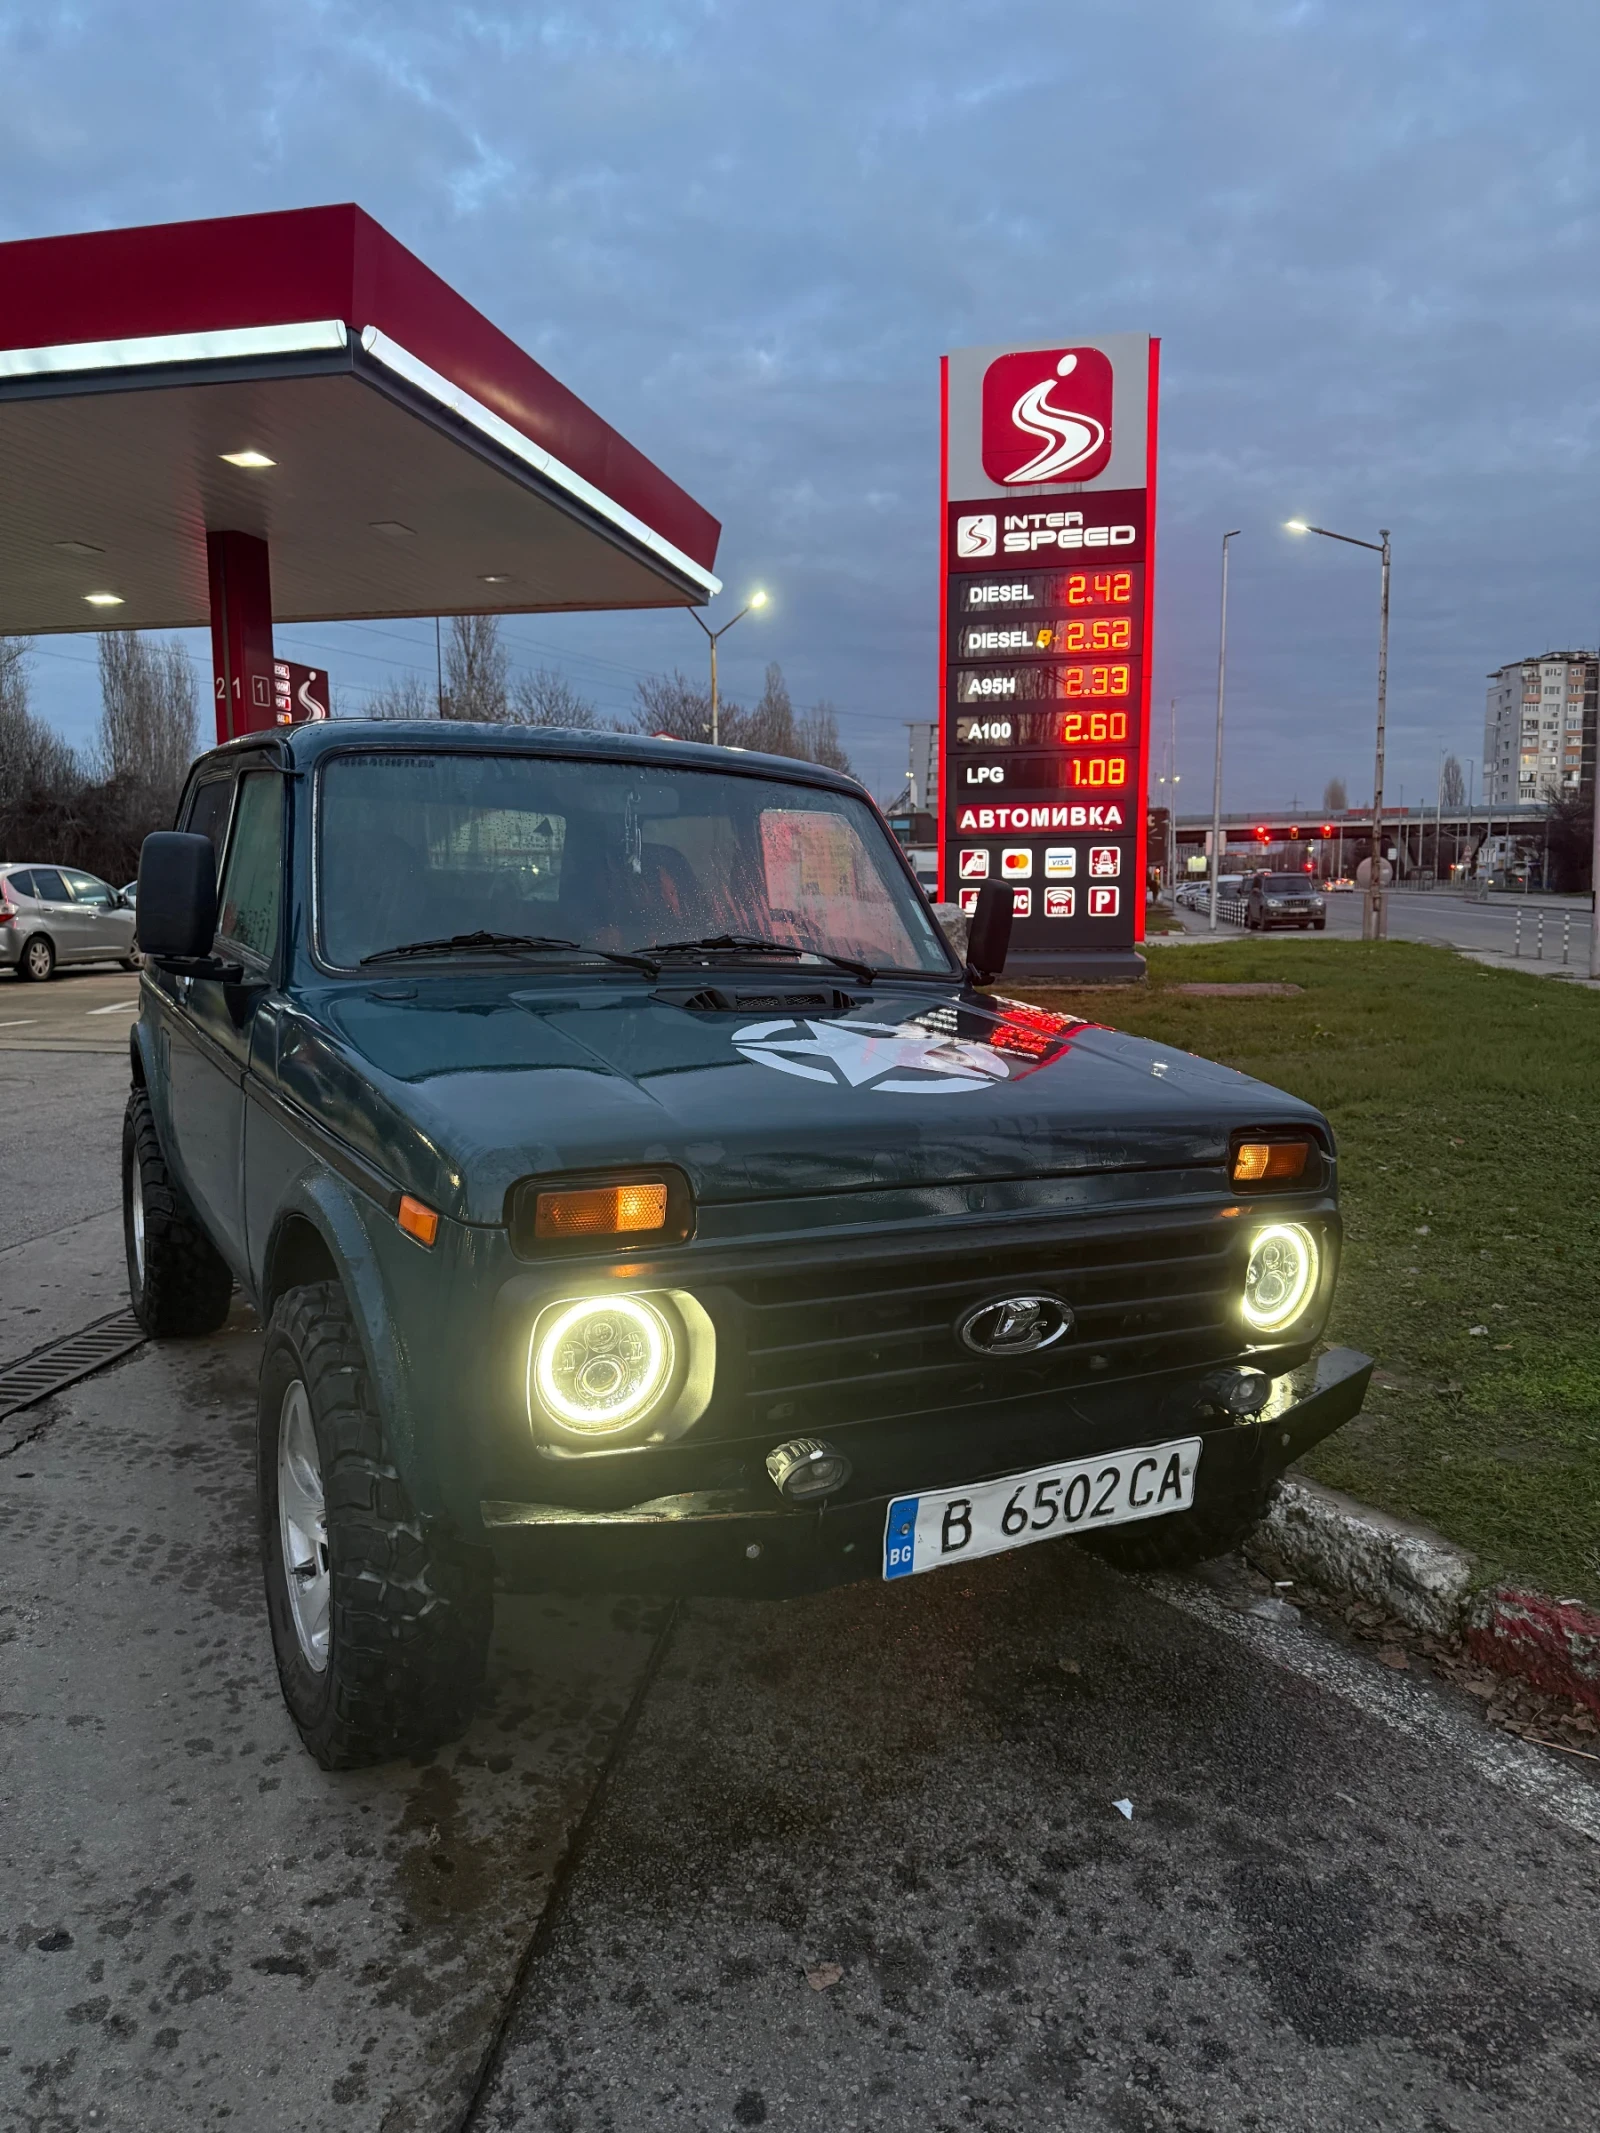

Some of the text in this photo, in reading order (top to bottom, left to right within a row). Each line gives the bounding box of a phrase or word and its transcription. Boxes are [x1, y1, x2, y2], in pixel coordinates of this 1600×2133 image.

[1003, 511, 1083, 530] INTER
[1003, 525, 1135, 552] SPEED
[969, 573, 1131, 604] DIESEL 2.42
[968, 630, 1033, 649] DIESEL
[1067, 620, 1129, 651] 2.52
[216, 677, 241, 699] 2 1
[256, 681, 265, 702] 1
[968, 666, 1129, 696] A95H 2.33
[968, 712, 1127, 742] A100 2.60
[966, 758, 1125, 785] LPG 1.08
[960, 805, 1123, 829] АВТОМИВКА
[1095, 890, 1111, 912] P
[941, 1452, 1183, 1555] B 6502 CA
[889, 1545, 912, 1566] BG
